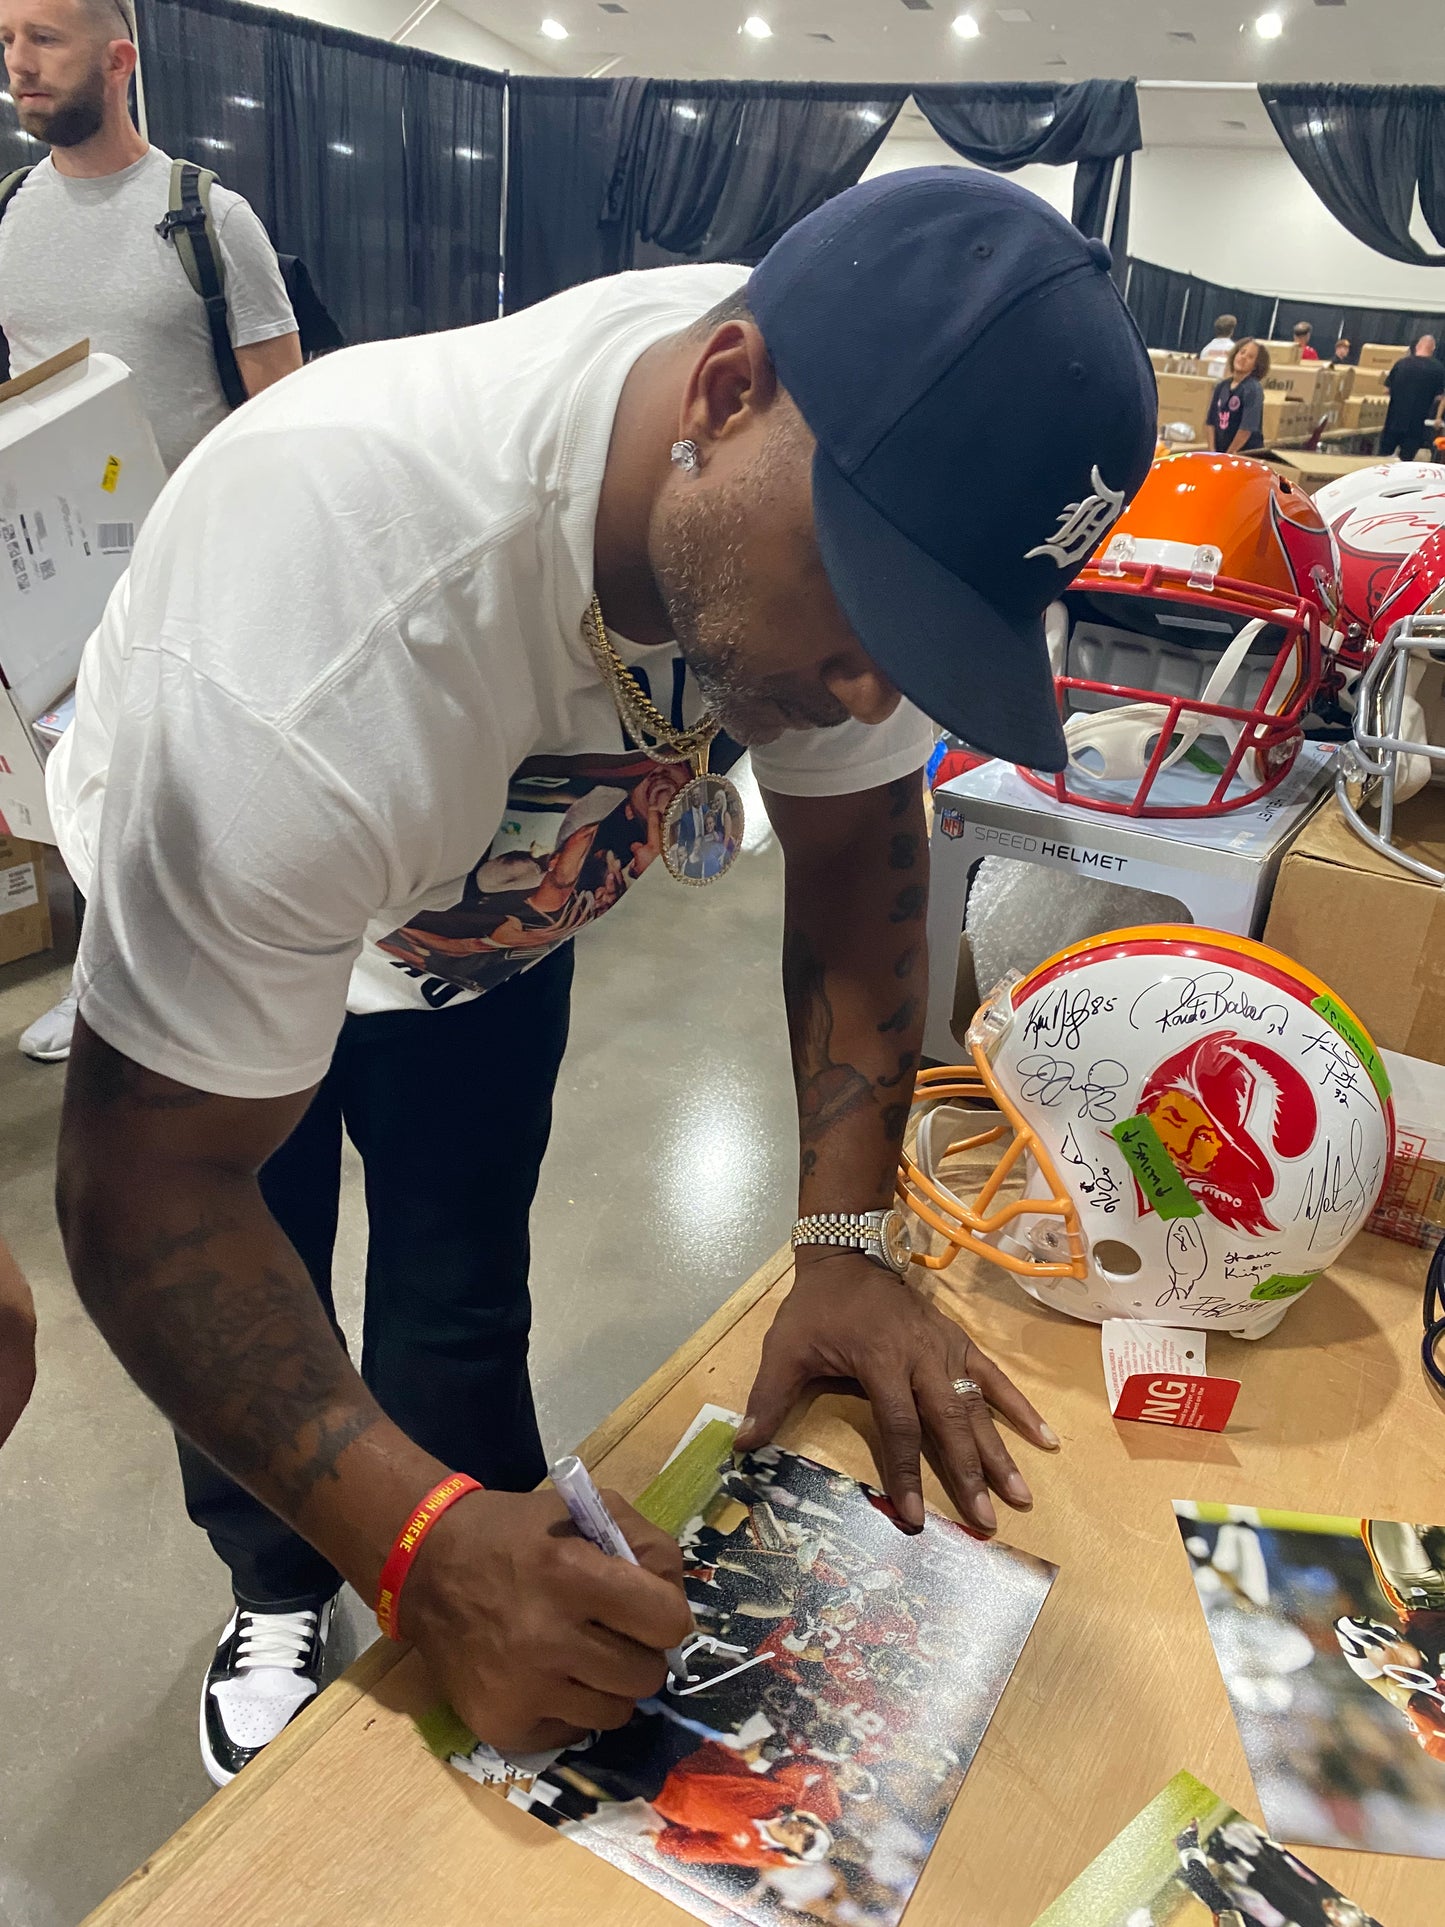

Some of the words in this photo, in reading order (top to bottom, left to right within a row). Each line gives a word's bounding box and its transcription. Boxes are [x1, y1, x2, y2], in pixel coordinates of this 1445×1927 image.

[974, 826, 1037, 851] SPEED
[1041, 841, 1128, 872] HELMET
[1333, 1088, 1349, 1108] 32
[1138, 1380, 1188, 1424] ING
[425, 1478, 465, 1512] GERMAN
[399, 1511, 431, 1552] KREME
